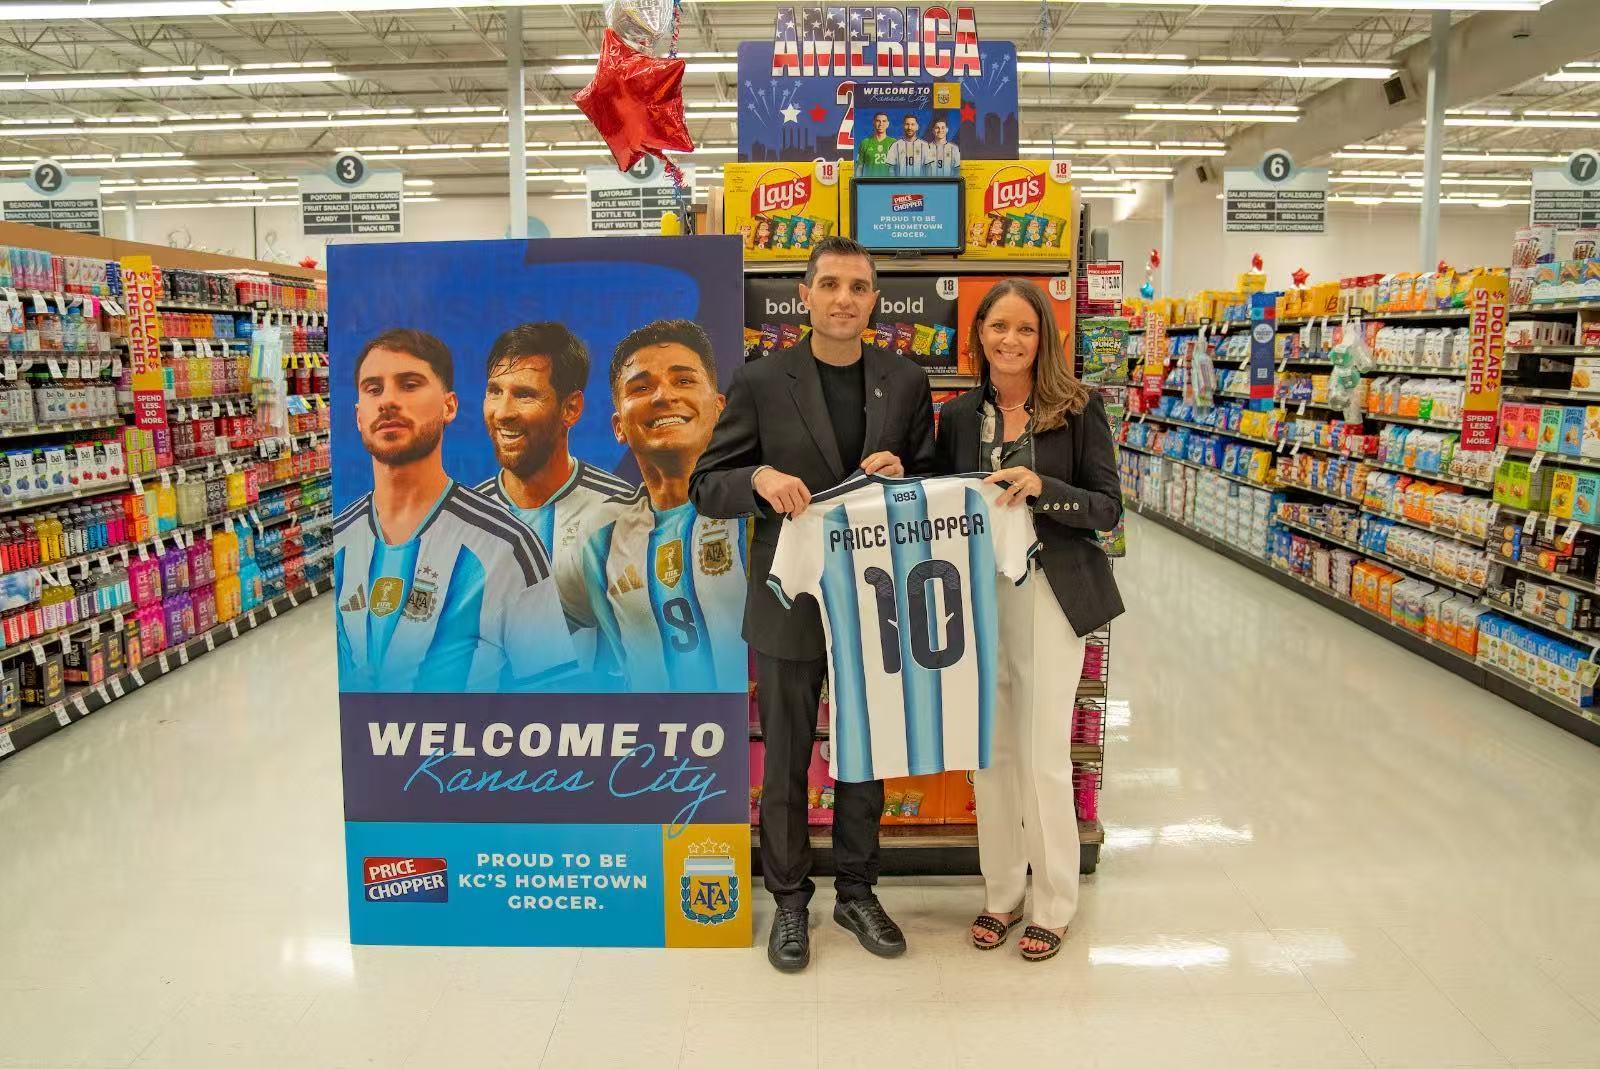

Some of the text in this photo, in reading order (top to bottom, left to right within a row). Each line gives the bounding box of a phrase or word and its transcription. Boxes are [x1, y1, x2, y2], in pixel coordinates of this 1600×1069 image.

[771, 6, 983, 77] AMERICA
[863, 87, 914, 95] WELCOME
[343, 159, 355, 179] 3
[633, 155, 648, 174] 4
[822, 164, 833, 176] 18
[1056, 163, 1067, 174] 18
[1270, 157, 1284, 177] 6
[1579, 157, 1592, 177] 7
[40, 167, 55, 187] 2
[759, 178, 806, 212] Lay's
[893, 195, 912, 204] PRICE
[992, 175, 1039, 209] Lay's
[893, 200, 923, 212] CHOPPER
[943, 280, 954, 291] 18
[1055, 280, 1067, 291] 18
[880, 296, 924, 314] bold
[125, 271, 146, 375] STRETCHER
[141, 286, 159, 361] DOLLAR
[1469, 290, 1489, 395] STRETCHER
[1487, 306, 1505, 379] DOLLAR
[1466, 437, 1492, 445] MORE.
[892, 490, 917, 502] 1893
[829, 513, 985, 552] PRICE CHOPPER
[863, 559, 966, 675] 10
[368, 722, 725, 757] WELCOME TO
[403, 743, 727, 839] Kansas City
[368, 859, 416, 880] PRICE
[477, 853, 627, 867] PROUD TO BE
[368, 874, 445, 900] CHOPPER
[515, 874, 647, 889] HOMETOWN
[508, 895, 604, 910] GROCER.
[692, 880, 727, 911] AFA
